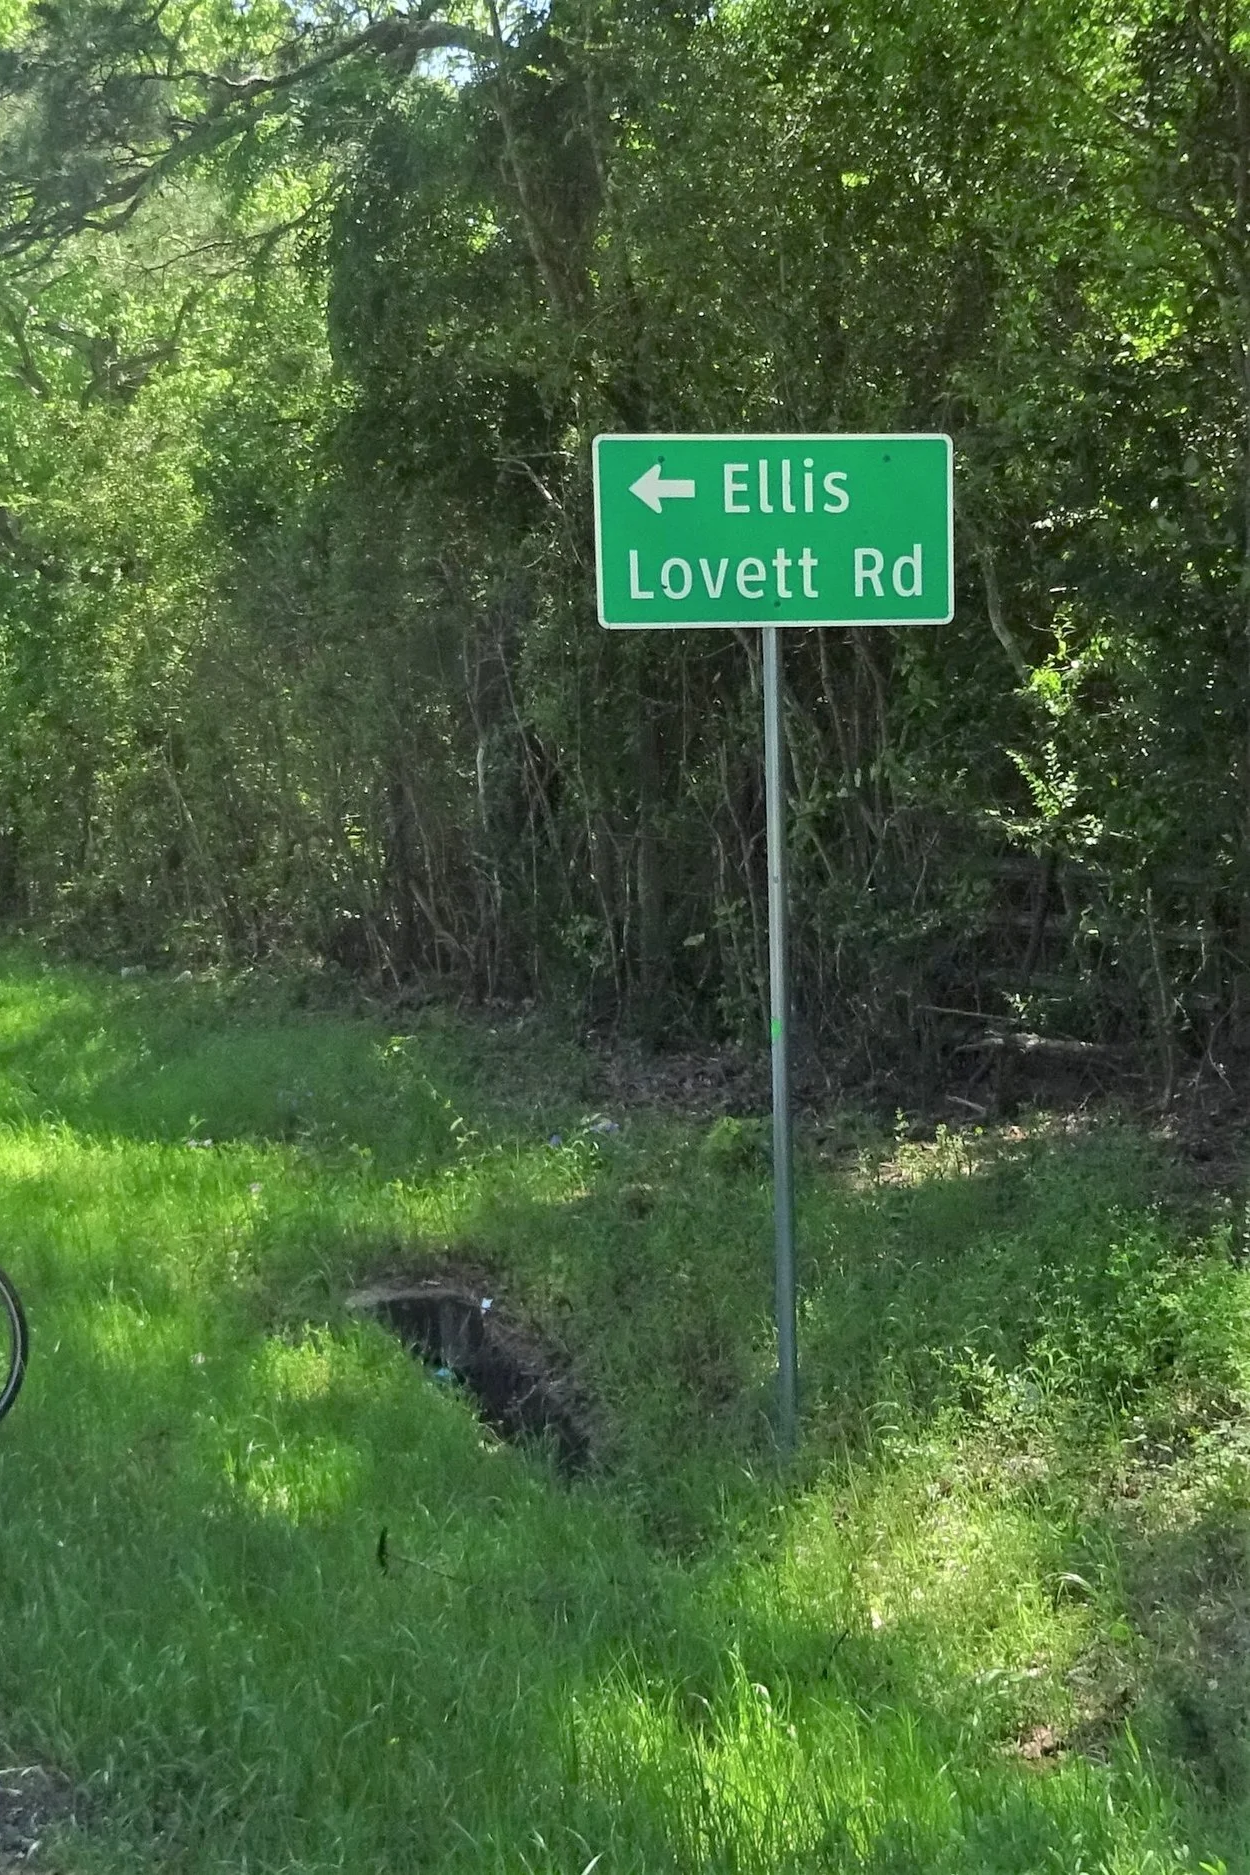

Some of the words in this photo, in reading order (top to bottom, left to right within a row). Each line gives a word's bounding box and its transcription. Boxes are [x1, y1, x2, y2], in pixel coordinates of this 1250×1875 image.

[724, 458, 850, 513] Ellis
[629, 547, 819, 600] Lovett
[854, 543, 923, 598] Rd
